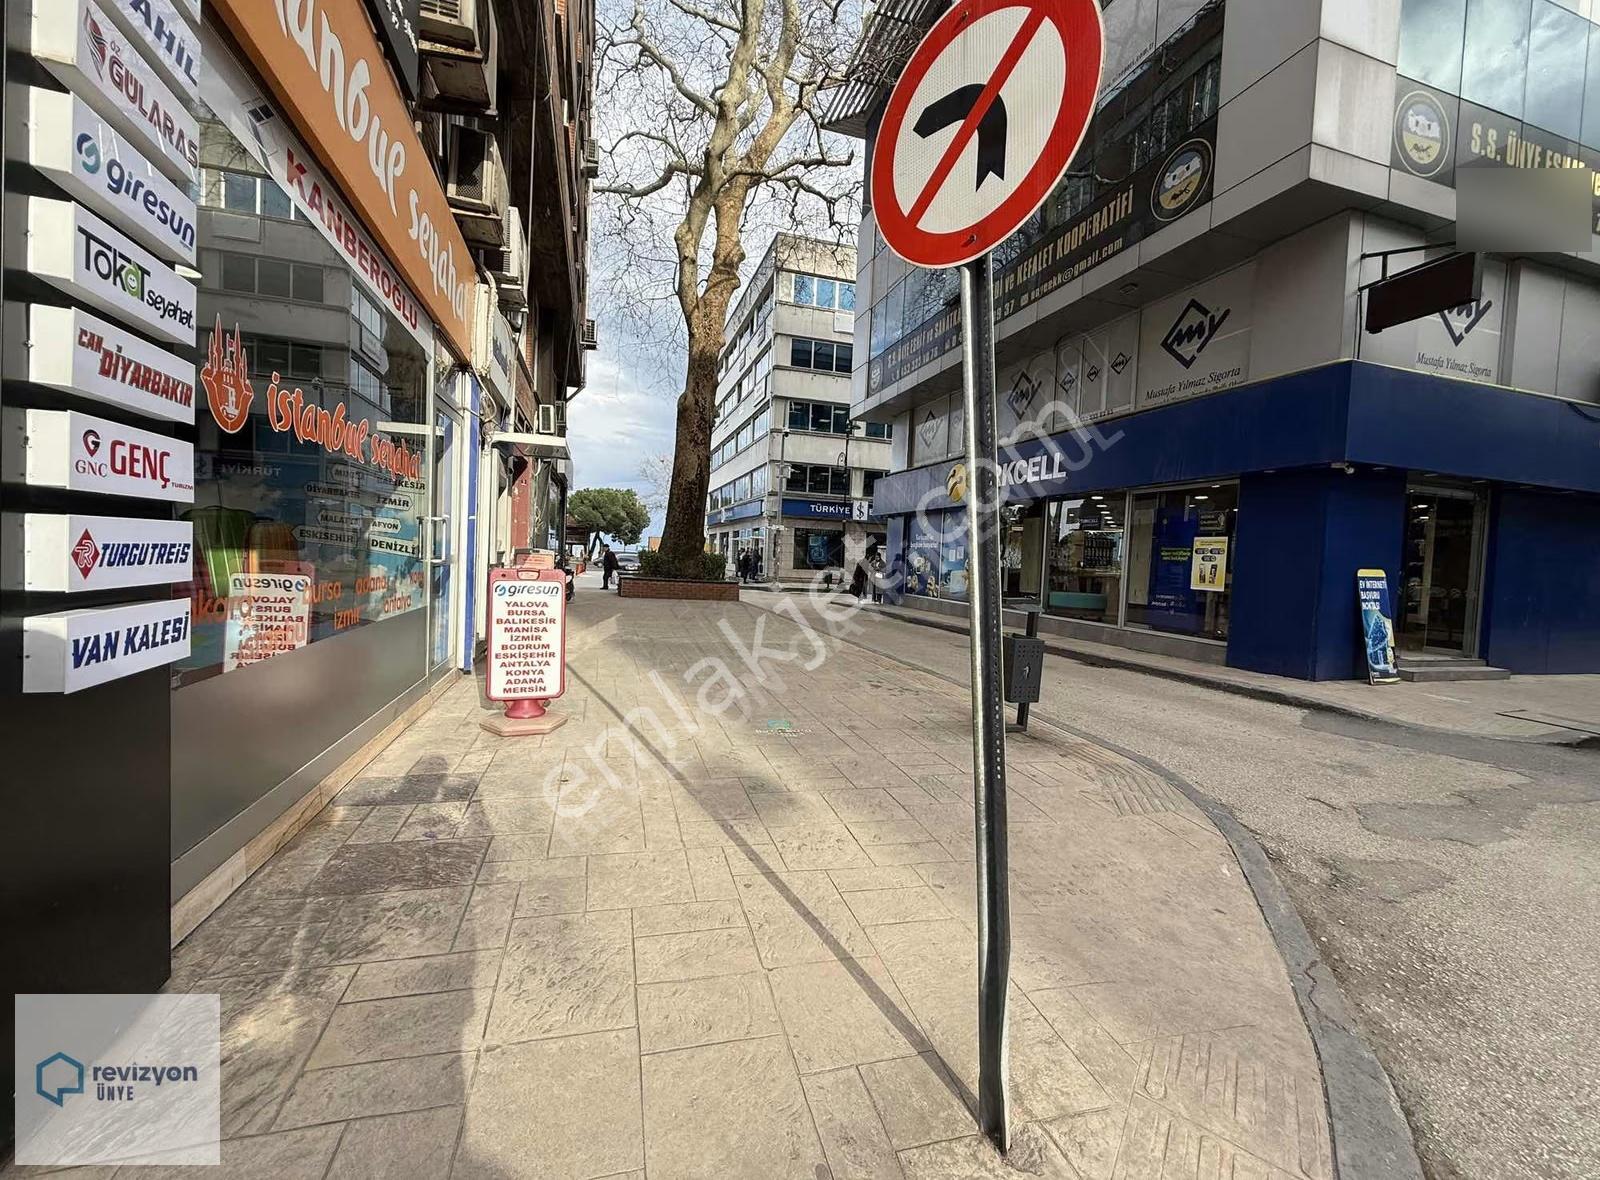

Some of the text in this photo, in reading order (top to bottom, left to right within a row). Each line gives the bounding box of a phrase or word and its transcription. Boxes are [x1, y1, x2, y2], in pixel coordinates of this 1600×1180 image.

[108, 55, 199, 169] GÜLARAS
[1471, 121, 1500, 162] S.S.
[106, 158, 196, 248] giresun
[1017, 243, 1055, 285] KEFALET
[1056, 184, 1134, 260] KOOPERATİFİ
[146, 287, 194, 331] seyahat
[77, 327, 104, 353] CAN
[98, 344, 194, 408] DİYARBAKIR
[1416, 352, 1492, 377] Mustafa Yılmaz Sigorta
[1144, 384, 1176, 401] Mustafa
[1178, 376, 1206, 392] Yılmaz
[1208, 367, 1241, 384] Sigorta
[110, 440, 171, 490] GENÇ
[995, 451, 1068, 487] RKCELL
[809, 502, 851, 515] TÜRKİYE
[372, 520, 399, 531] AFYON
[99, 541, 190, 568] TURGUTREİS
[508, 584, 559, 596] giresun
[496, 617, 557, 625] BALIKESİR
[507, 609, 546, 617] BURSA
[71, 627, 119, 671] VAN
[124, 612, 189, 657] KALESİ
[504, 625, 548, 633] MANİSA
[510, 633, 542, 641] İZMİR
[494, 651, 556, 660] ESKİŞEHİR
[503, 685, 547, 694] MERSİN
[505, 677, 545, 685] ADANA
